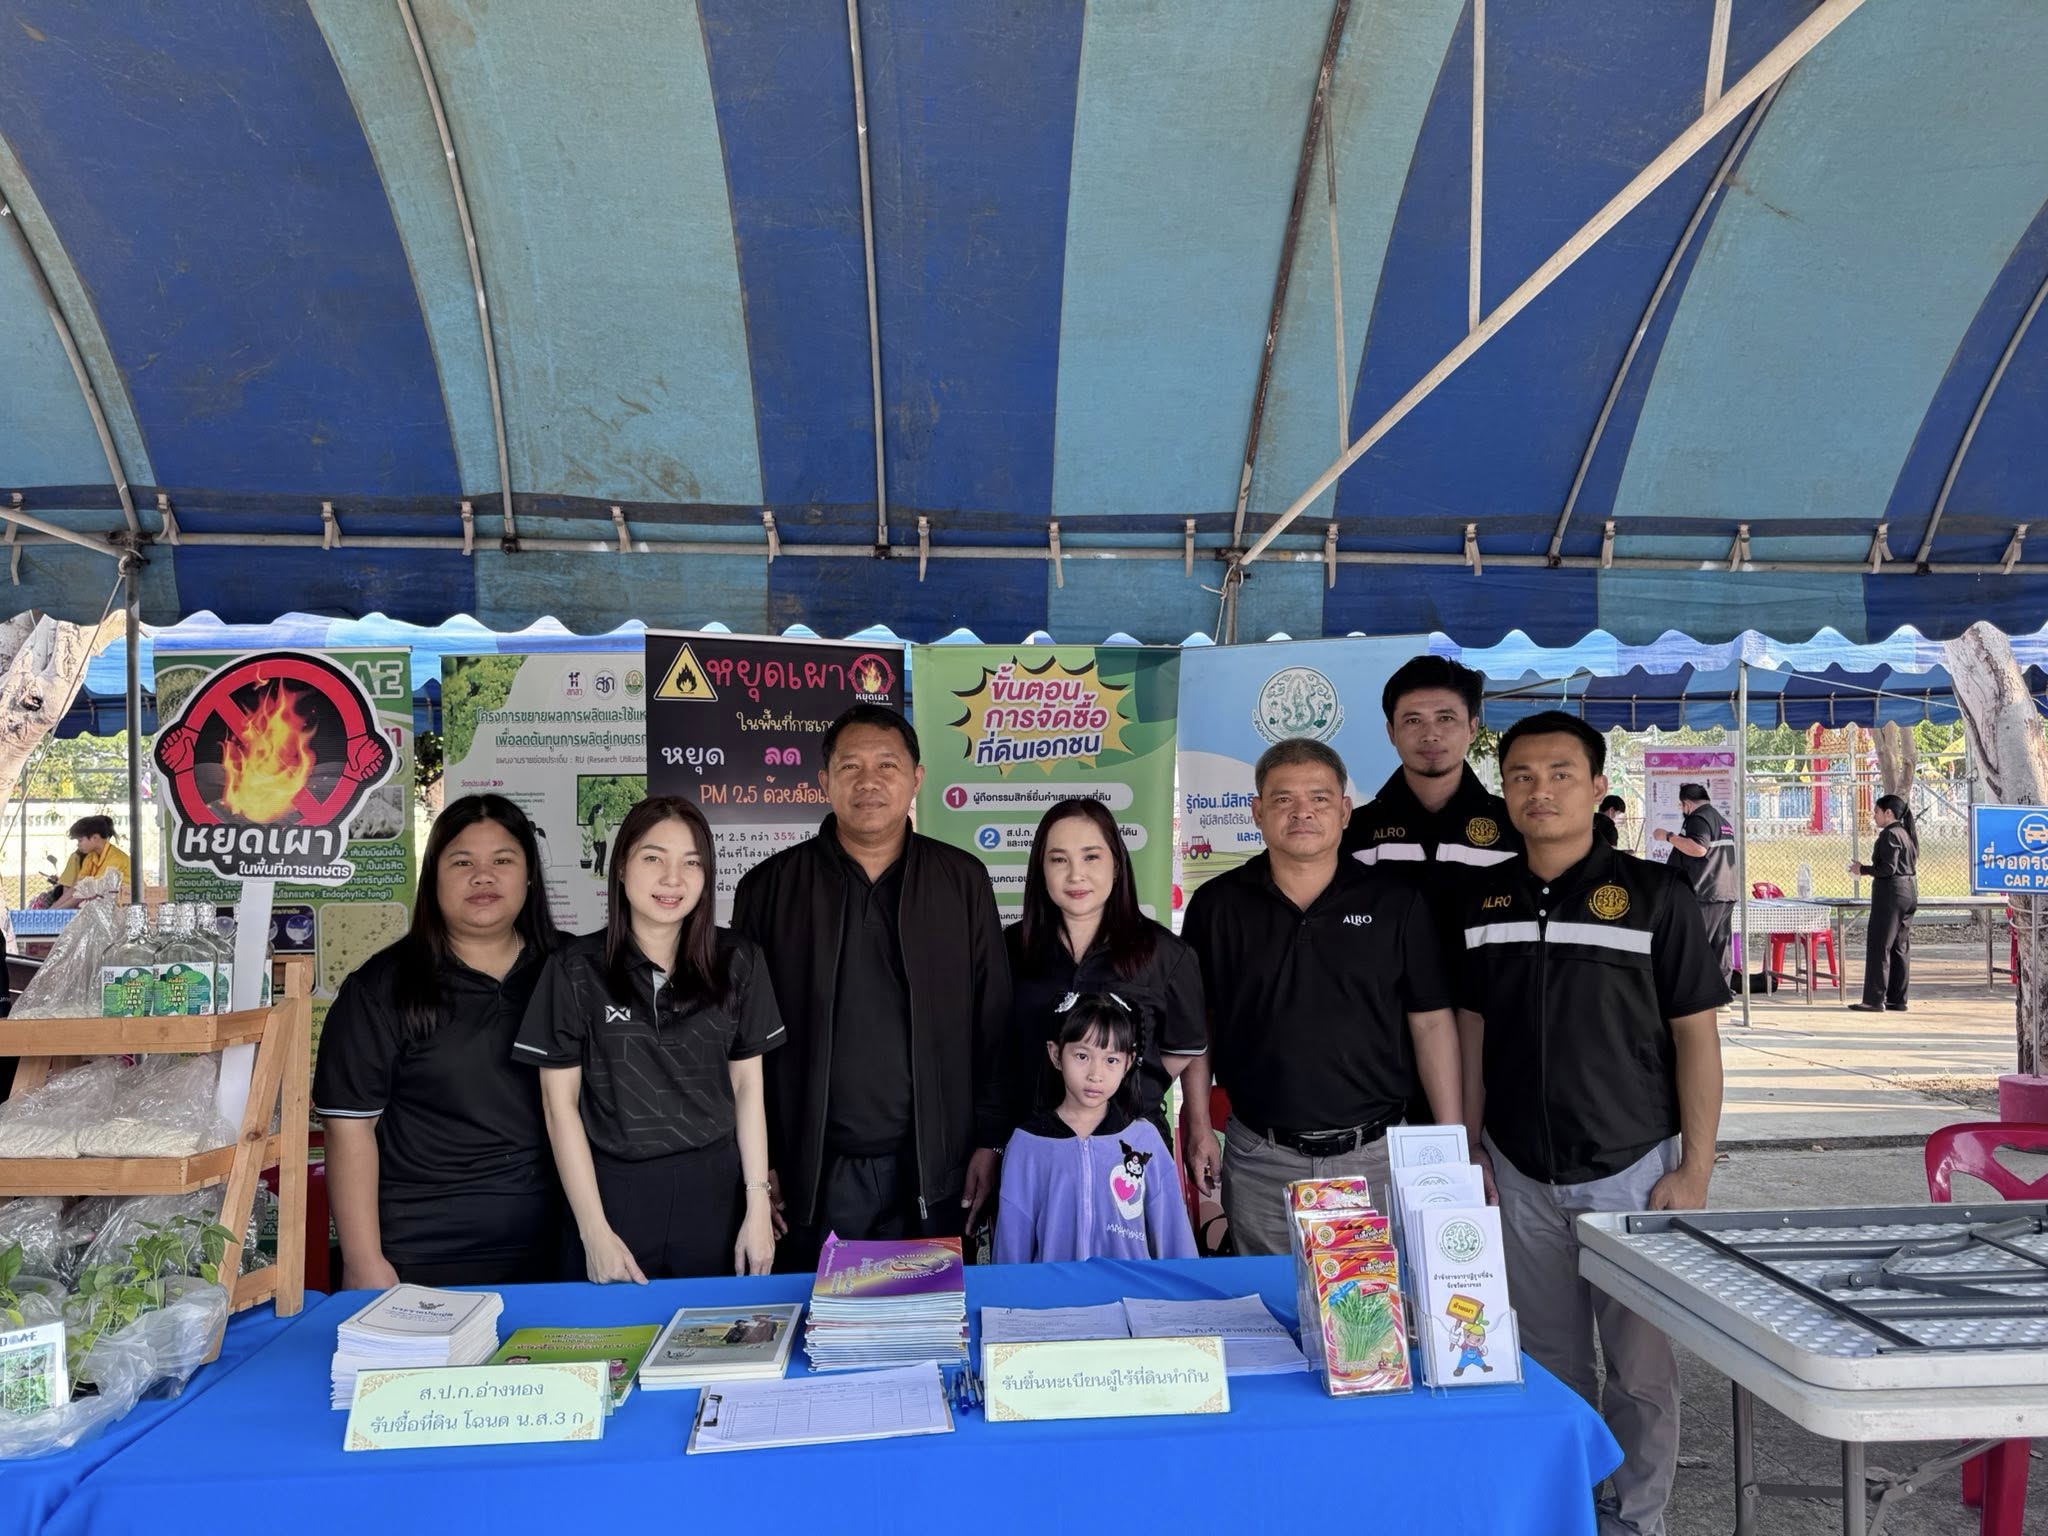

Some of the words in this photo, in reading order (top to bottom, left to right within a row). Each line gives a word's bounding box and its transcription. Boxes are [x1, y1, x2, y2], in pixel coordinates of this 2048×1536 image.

[705, 658, 845, 702] หยุดเผา
[992, 666, 1081, 702] ขั้นตอน
[985, 694, 1108, 729] การจัดซื้อ
[977, 731, 1101, 765] ที่ดินเอกชน
[587, 756, 617, 765] (Research
[661, 746, 725, 775] หยุด
[763, 746, 802, 767] ลด
[700, 783, 728, 804] PM
[732, 785, 758, 804] 2.5
[728, 833, 746, 842] 2.5
[750, 831, 769, 841] กว่า
[773, 831, 796, 841] 35%
[1373, 826, 1406, 841] ALRO
[184, 826, 333, 864] หยุดเผา
[239, 858, 350, 877] ในพื้นที่การเกษตร
[2004, 874, 2031, 886] CAR
[322, 890, 365, 902] Endophytic
[1482, 894, 1512, 910] ALRO
[1343, 914, 1372, 925] ALRO
[1001, 1365, 1210, 1392] รับขึ้นทะเบียนผู้ไร้ที่ดินทำกิน
[419, 1381, 544, 1401] ส.ป.ก.อ่างทอง
[370, 1409, 458, 1435] รับซื้อที่ดิน
[464, 1409, 509, 1430] โฉนด
[572, 1411, 584, 1425] ก
